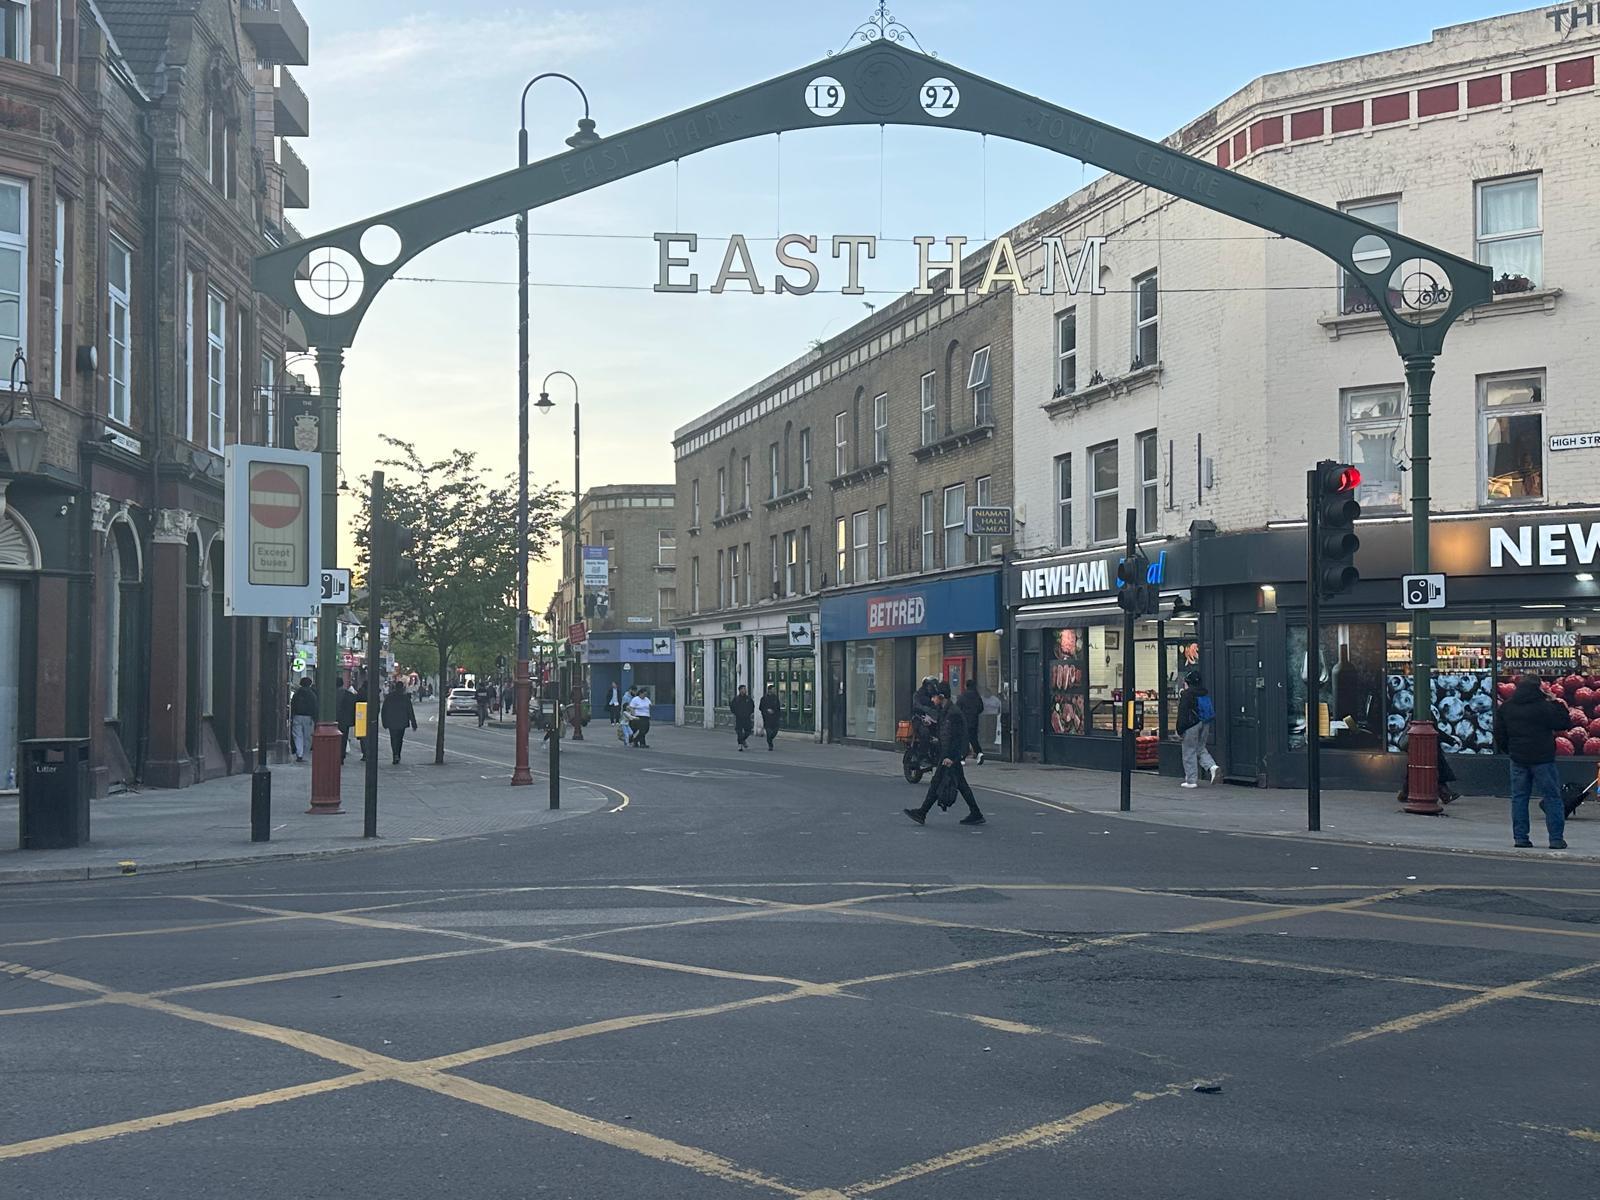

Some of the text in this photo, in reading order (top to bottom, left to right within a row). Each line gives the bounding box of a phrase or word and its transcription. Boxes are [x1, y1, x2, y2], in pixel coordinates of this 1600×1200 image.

[1546, 2, 1600, 32] TH
[813, 86, 954, 109] 19 92
[559, 111, 725, 185] EAST HAM
[1037, 111, 1223, 198] TOWN CENTRE
[654, 233, 1107, 296] EAST HAM
[1552, 437, 1577, 447] HIGH
[257, 547, 290, 558] Except
[260, 559, 288, 567] buses
[1021, 559, 1109, 599] NEWHAM
[869, 596, 925, 628] BETFRED
[1504, 634, 1576, 647] FIREWORKS
[1503, 660, 1568, 668] ZEUS FIREWORKS
[1505, 648, 1576, 658] ON SALE HERE
